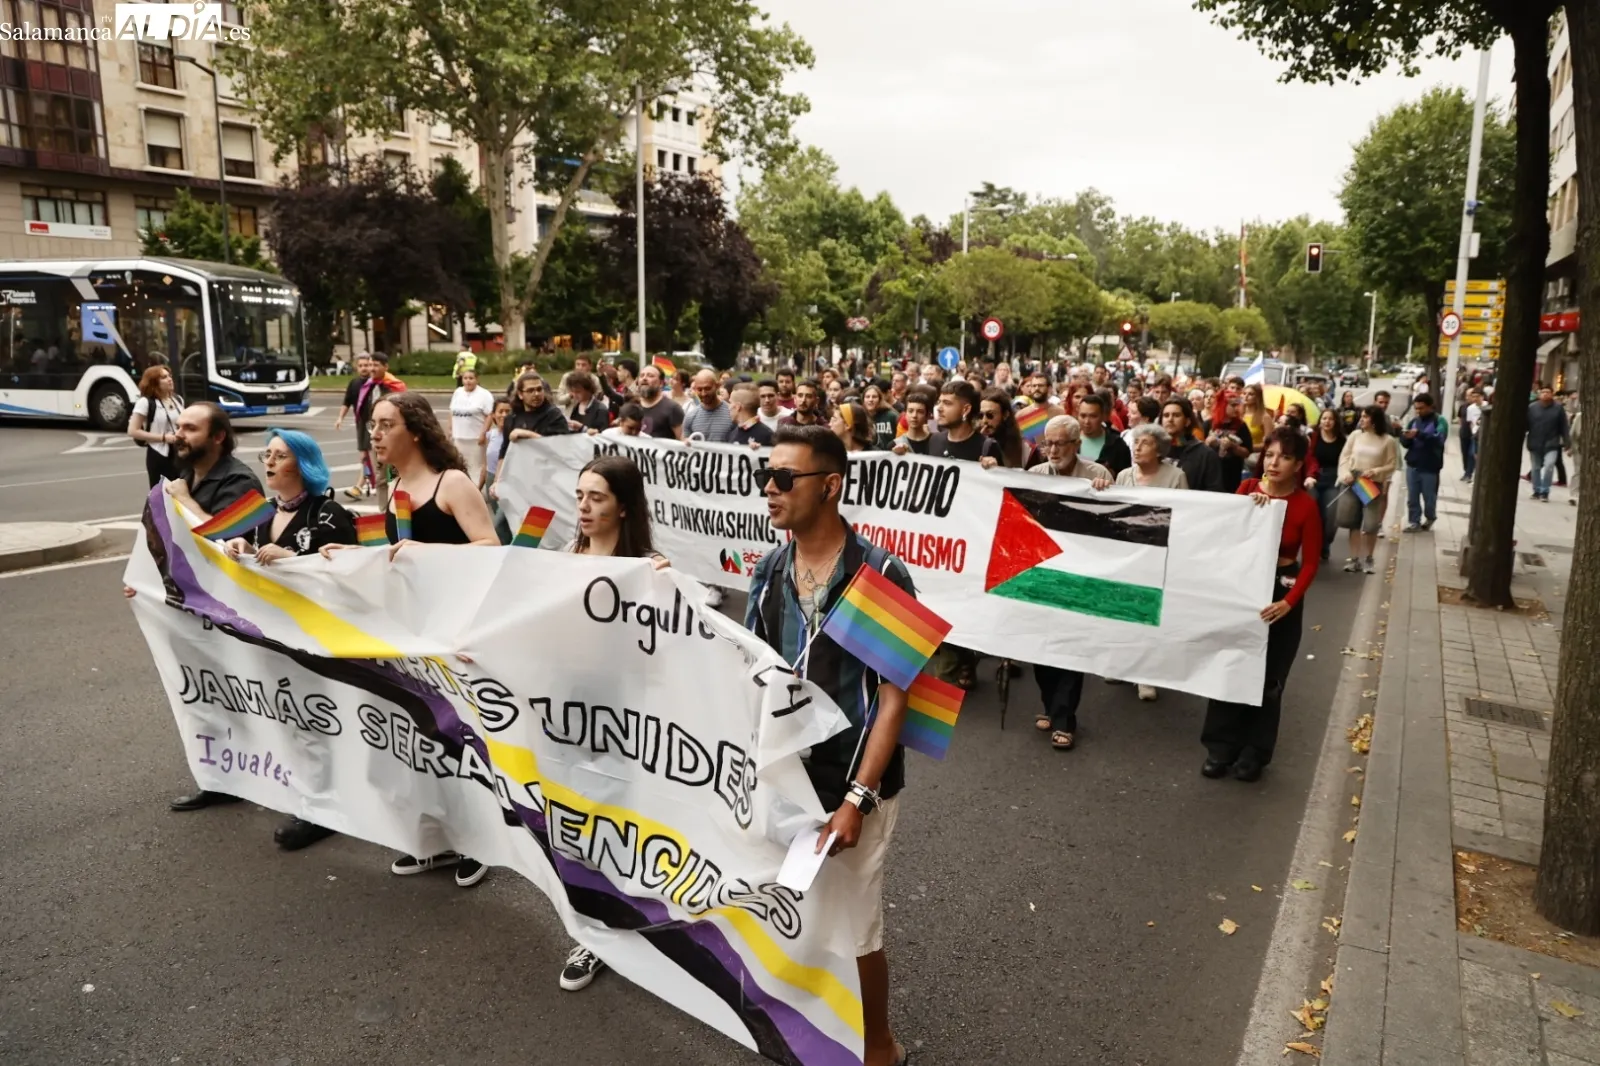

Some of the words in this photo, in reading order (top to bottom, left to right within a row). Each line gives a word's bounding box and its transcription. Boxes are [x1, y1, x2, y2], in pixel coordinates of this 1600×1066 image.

[986, 324, 998, 333] 30
[1445, 320, 1457, 330] 30
[663, 449, 751, 497] ORGULLO
[842, 458, 961, 518] ENOCIDIO
[654, 499, 670, 526] EL
[671, 502, 782, 546] PINKWASHING,
[179, 664, 342, 736] JAMÁS
[528, 696, 757, 830] UNIDES
